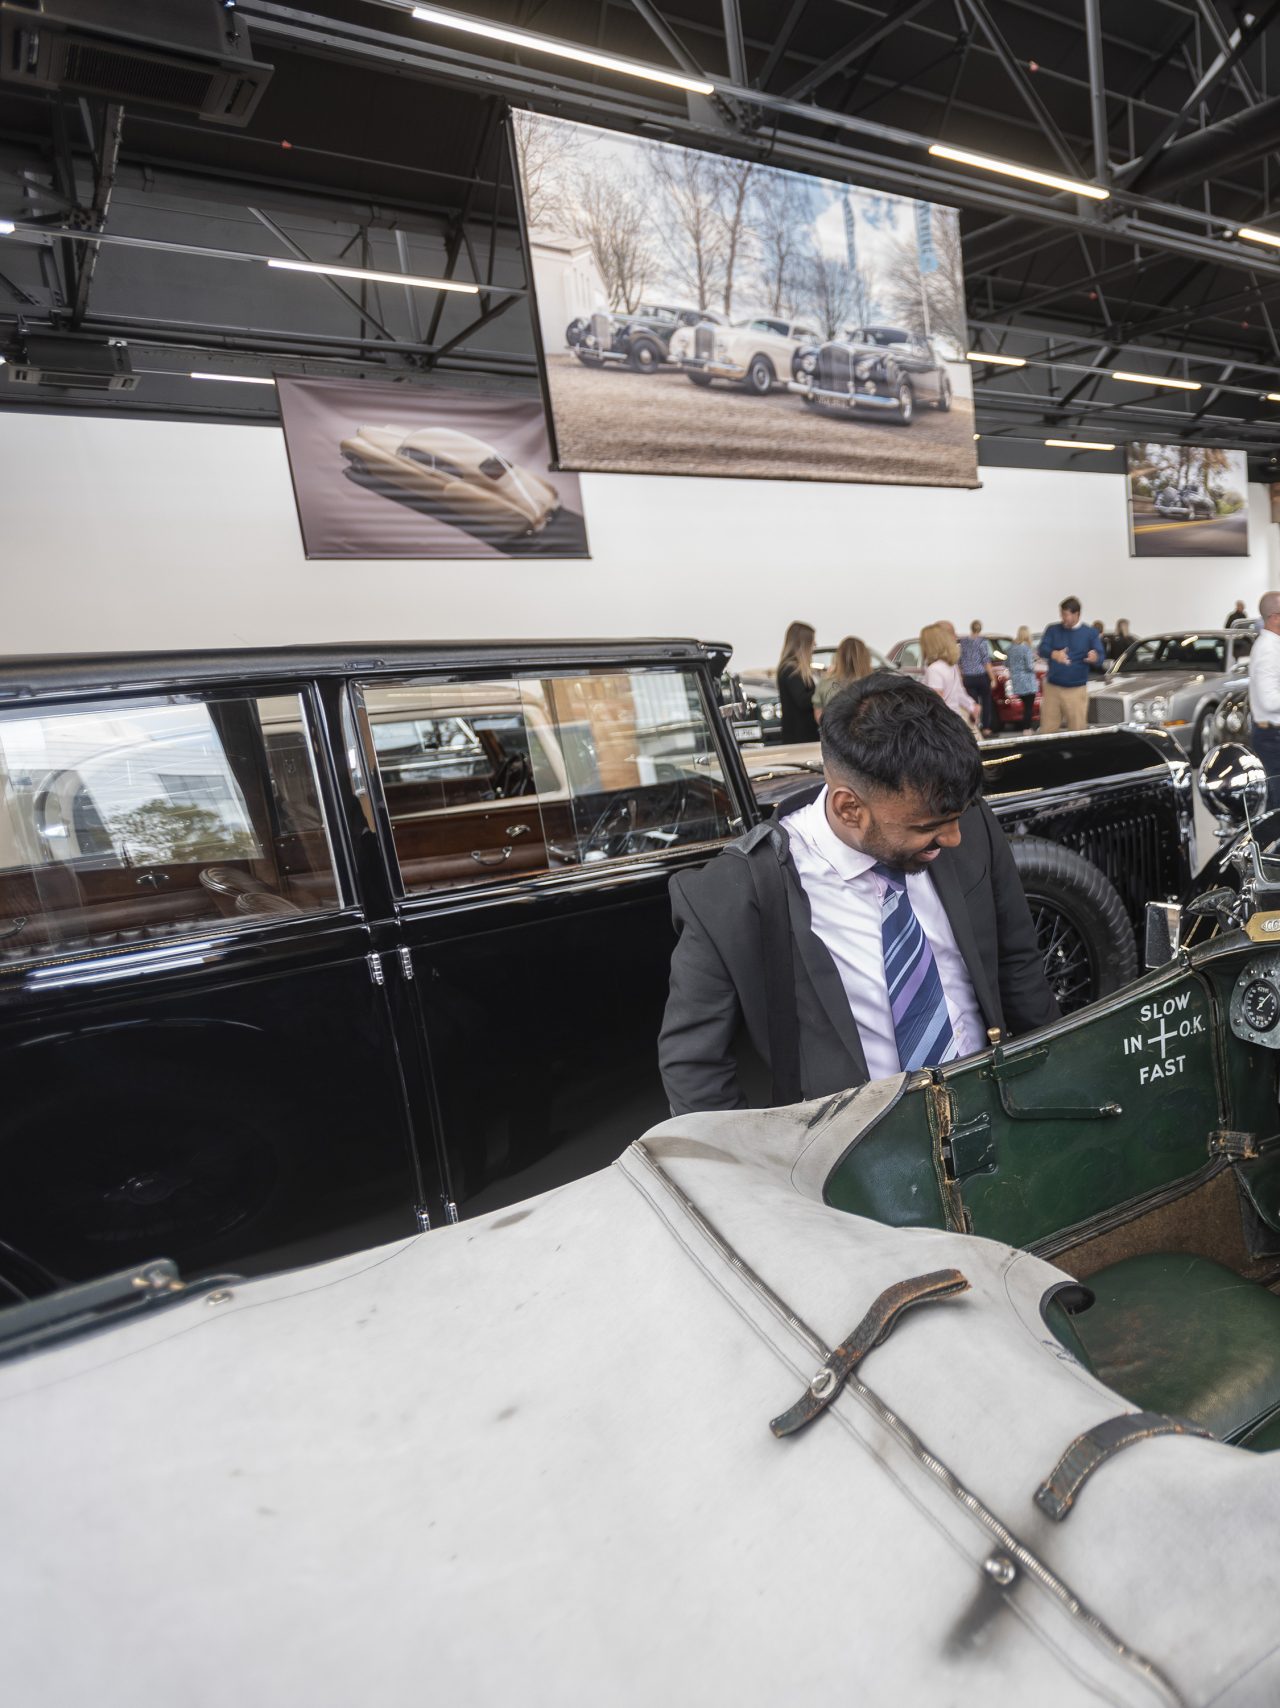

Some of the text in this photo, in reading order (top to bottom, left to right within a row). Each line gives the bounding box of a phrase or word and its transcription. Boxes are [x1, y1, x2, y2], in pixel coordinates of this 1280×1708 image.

[1140, 991, 1191, 1022] SLOW
[1123, 1015, 1206, 1055] IN O.K.
[1139, 1055, 1186, 1085] FAST
